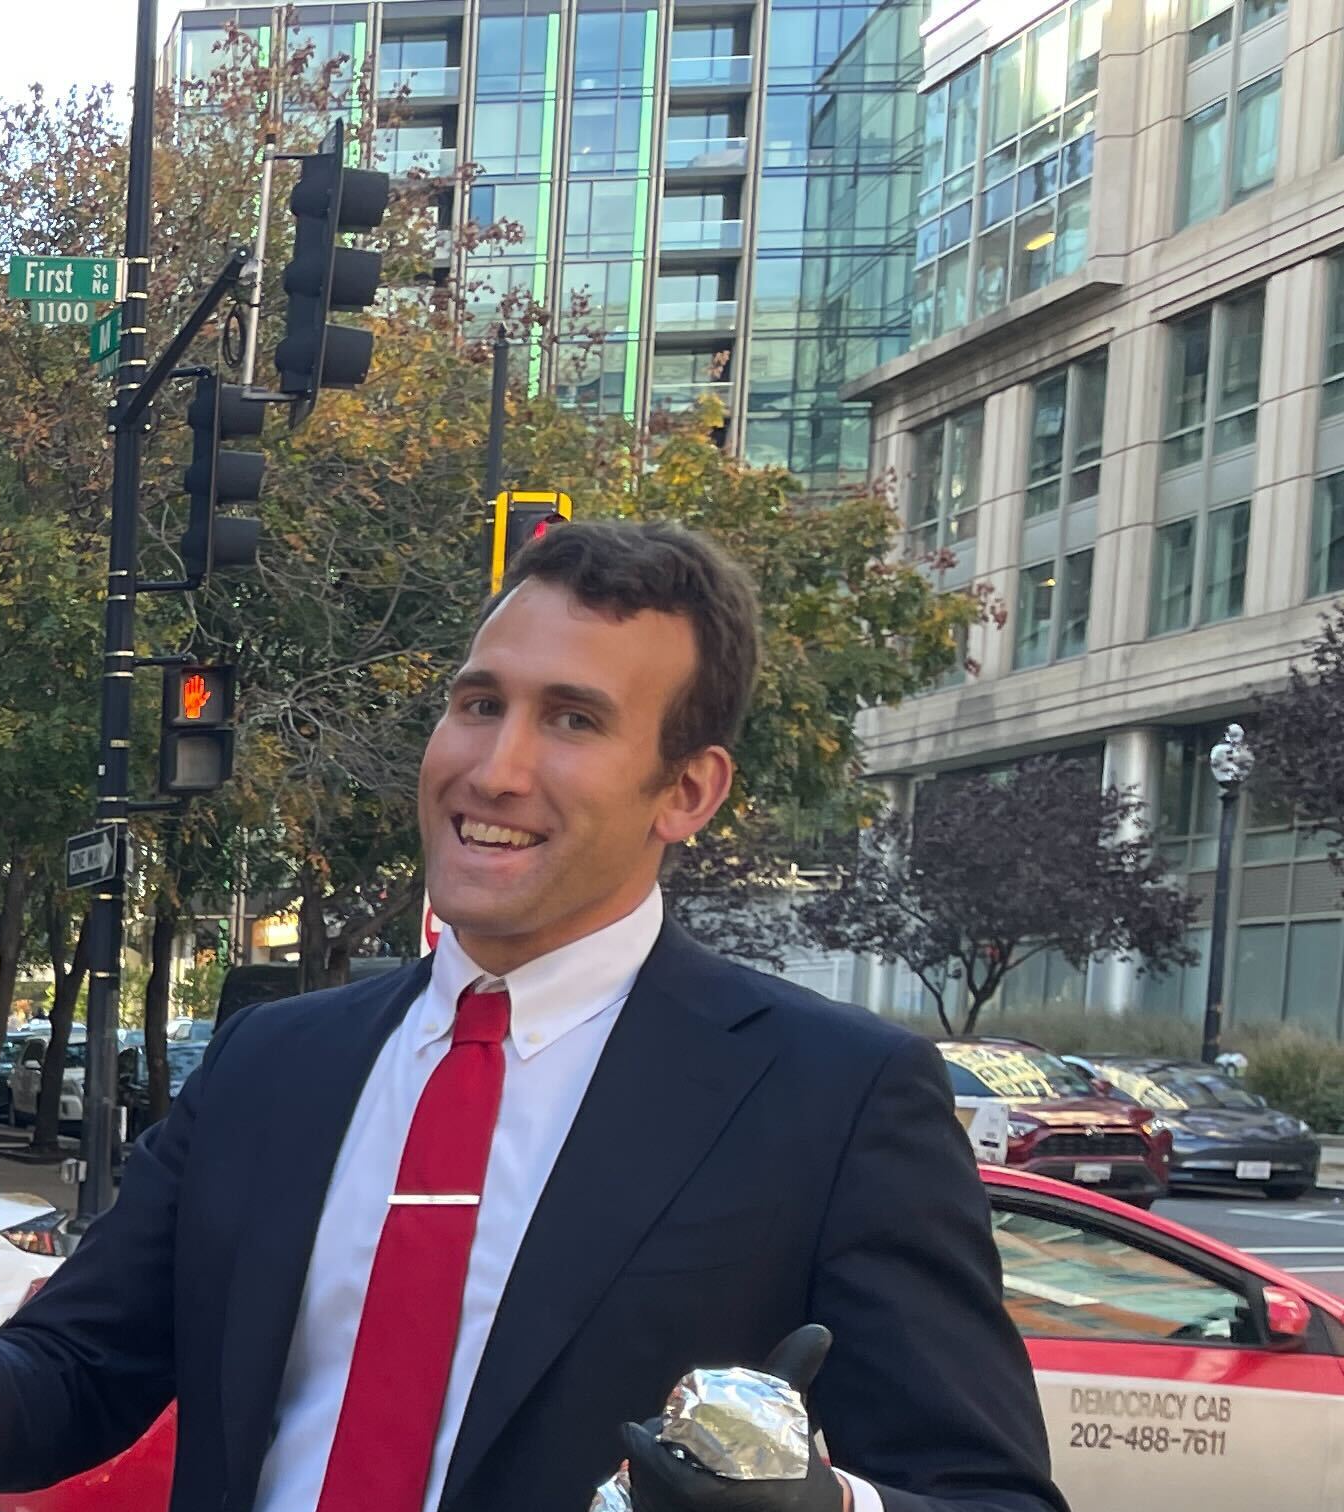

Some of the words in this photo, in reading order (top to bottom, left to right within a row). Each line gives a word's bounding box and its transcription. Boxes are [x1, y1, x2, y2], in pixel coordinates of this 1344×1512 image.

[24, 261, 74, 293] First
[92, 279, 110, 295] Ne
[93, 264, 108, 279] St
[37, 302, 89, 323] 1100
[99, 320, 112, 354] M
[1070, 1388, 1187, 1420] DEMOCRACY
[1194, 1395, 1232, 1422] CAB
[1070, 1422, 1227, 1455] 202-488-7611
